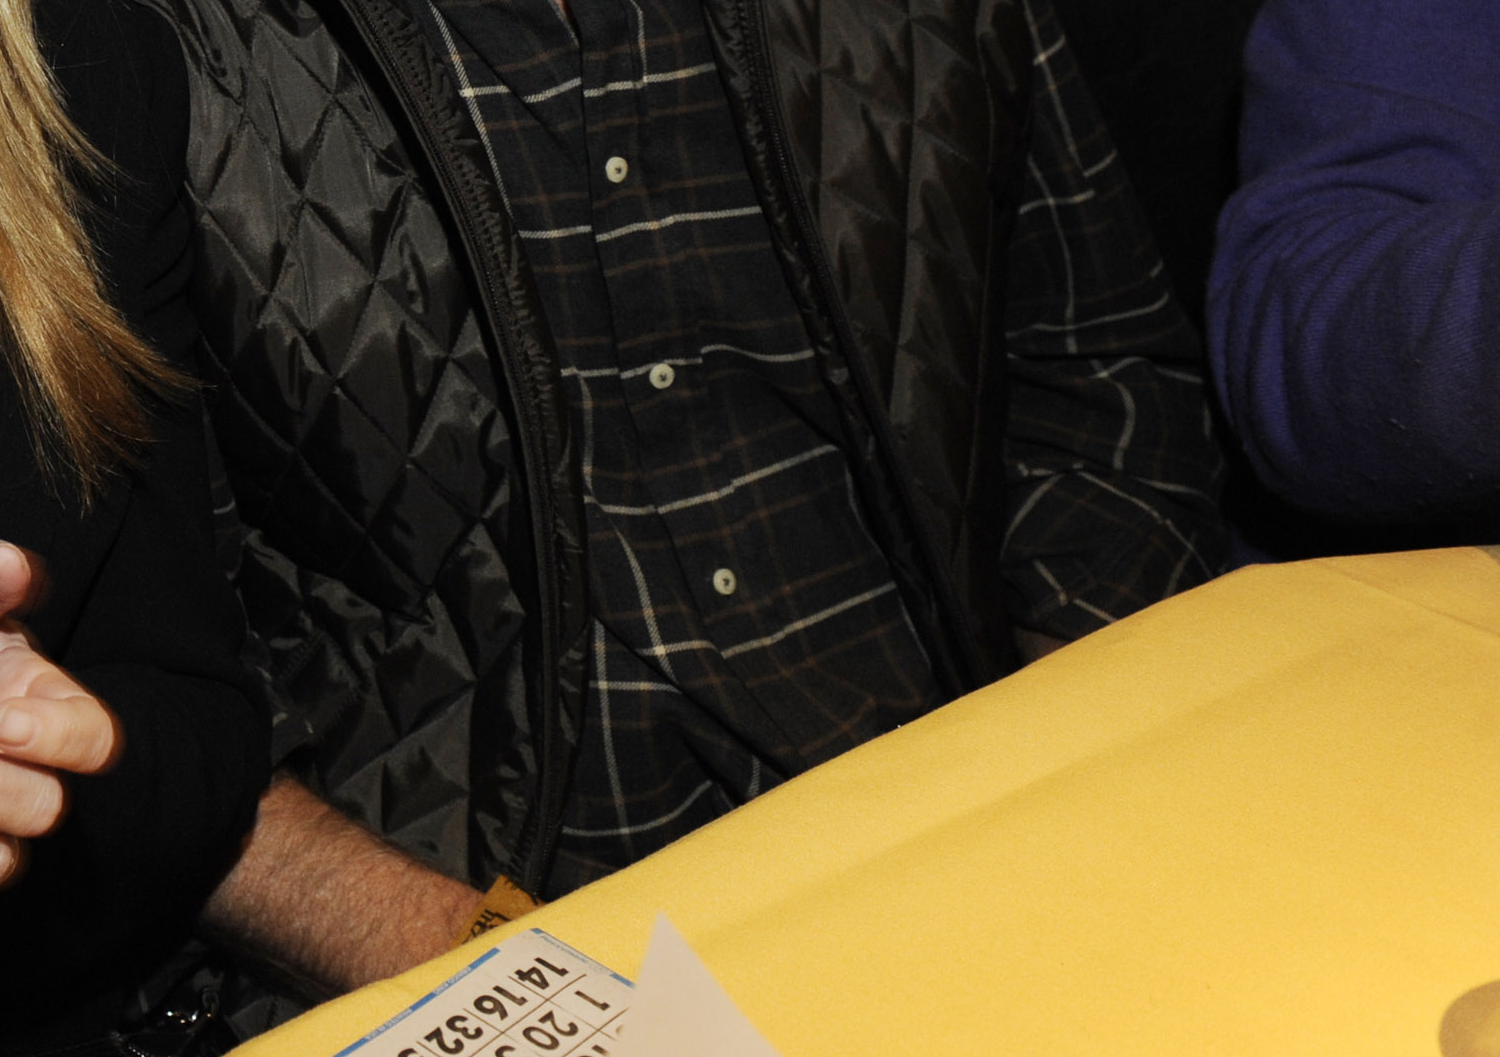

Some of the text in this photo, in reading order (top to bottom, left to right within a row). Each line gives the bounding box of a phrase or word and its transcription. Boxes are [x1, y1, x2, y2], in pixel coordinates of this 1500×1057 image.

[514, 957, 569, 990] 14
[473, 985, 528, 1021] 16
[574, 990, 611, 1011] 1
[424, 1014, 484, 1055] 32
[522, 1010, 579, 1051] 20
